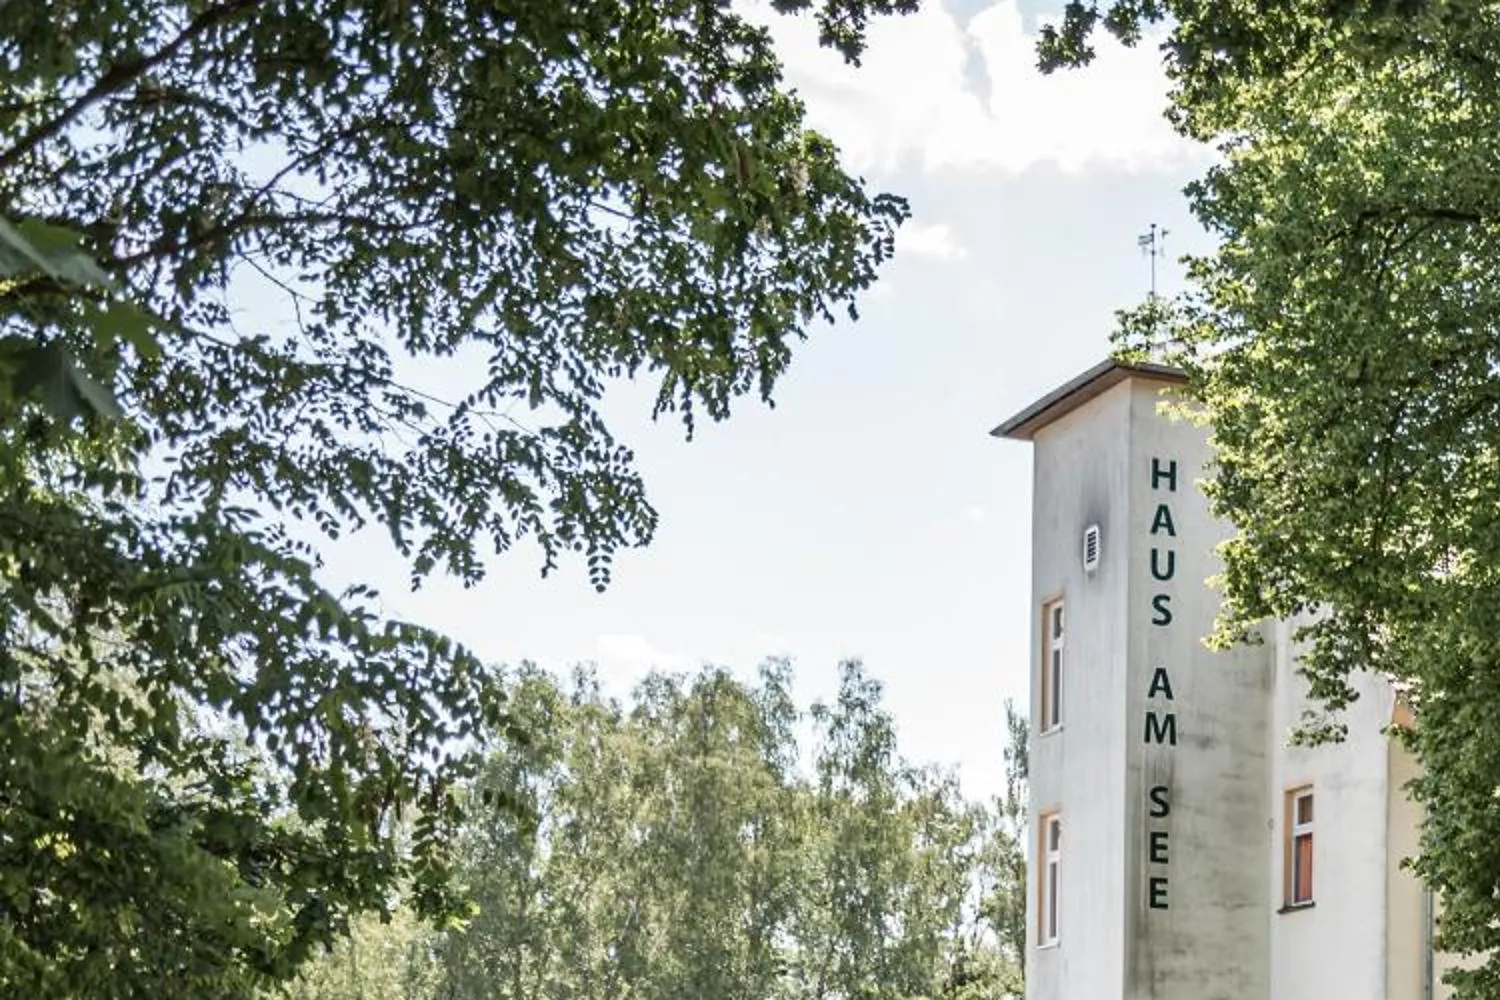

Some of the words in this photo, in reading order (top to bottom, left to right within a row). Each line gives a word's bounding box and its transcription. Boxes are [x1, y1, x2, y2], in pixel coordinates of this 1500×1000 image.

[1149, 456, 1177, 627] HAUS
[1143, 667, 1177, 746] AM
[1148, 785, 1170, 910] SEE
